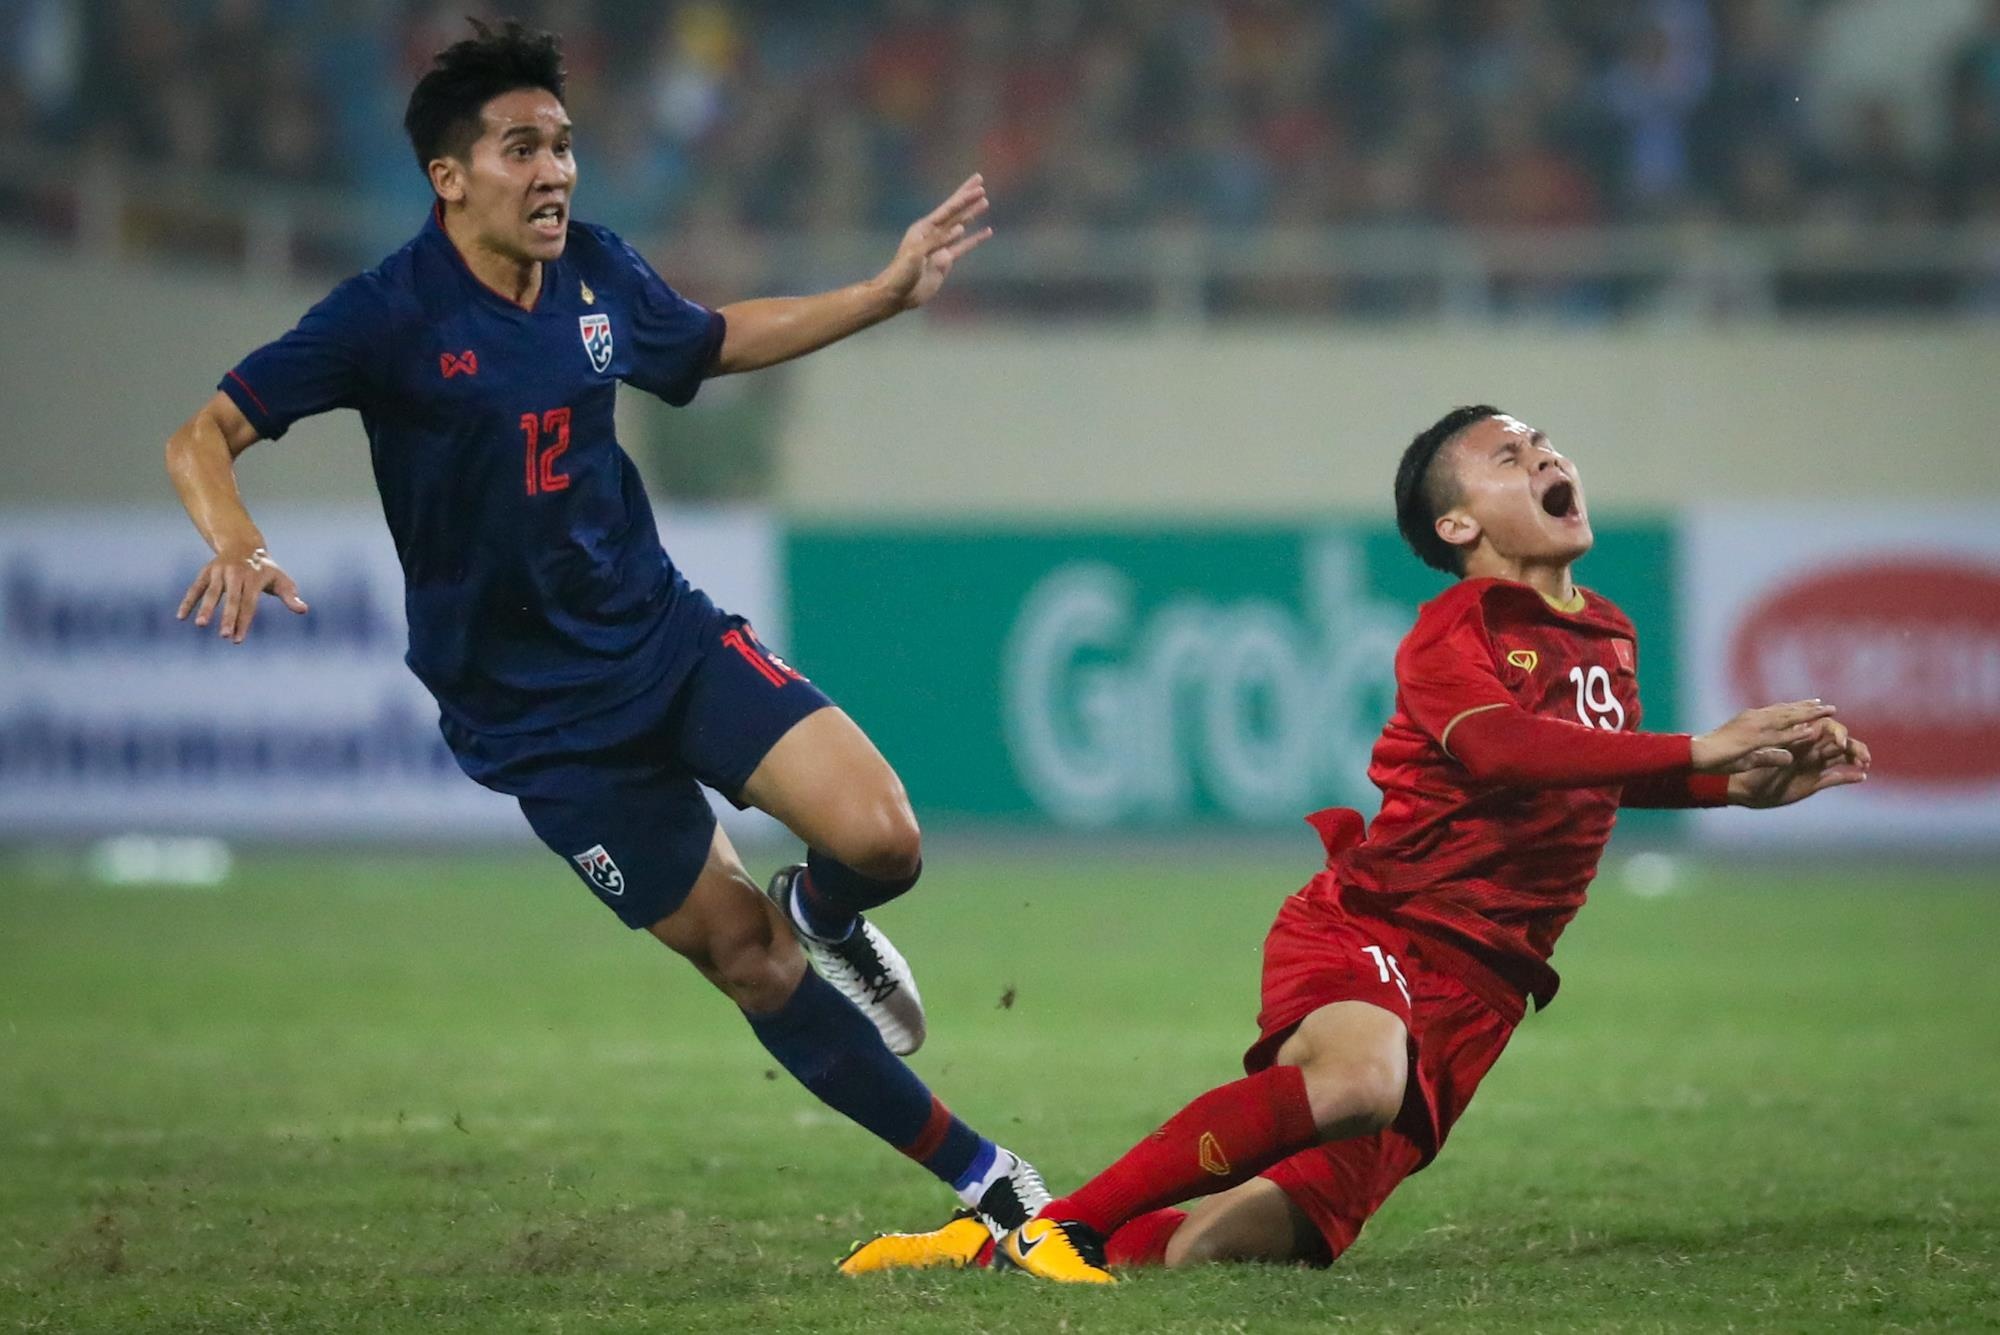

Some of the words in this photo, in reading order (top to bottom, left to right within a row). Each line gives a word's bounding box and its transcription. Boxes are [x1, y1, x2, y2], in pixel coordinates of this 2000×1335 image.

[520, 406, 572, 496] 12
[1003, 533, 1408, 827] Grab
[1569, 665, 1625, 734] 19
